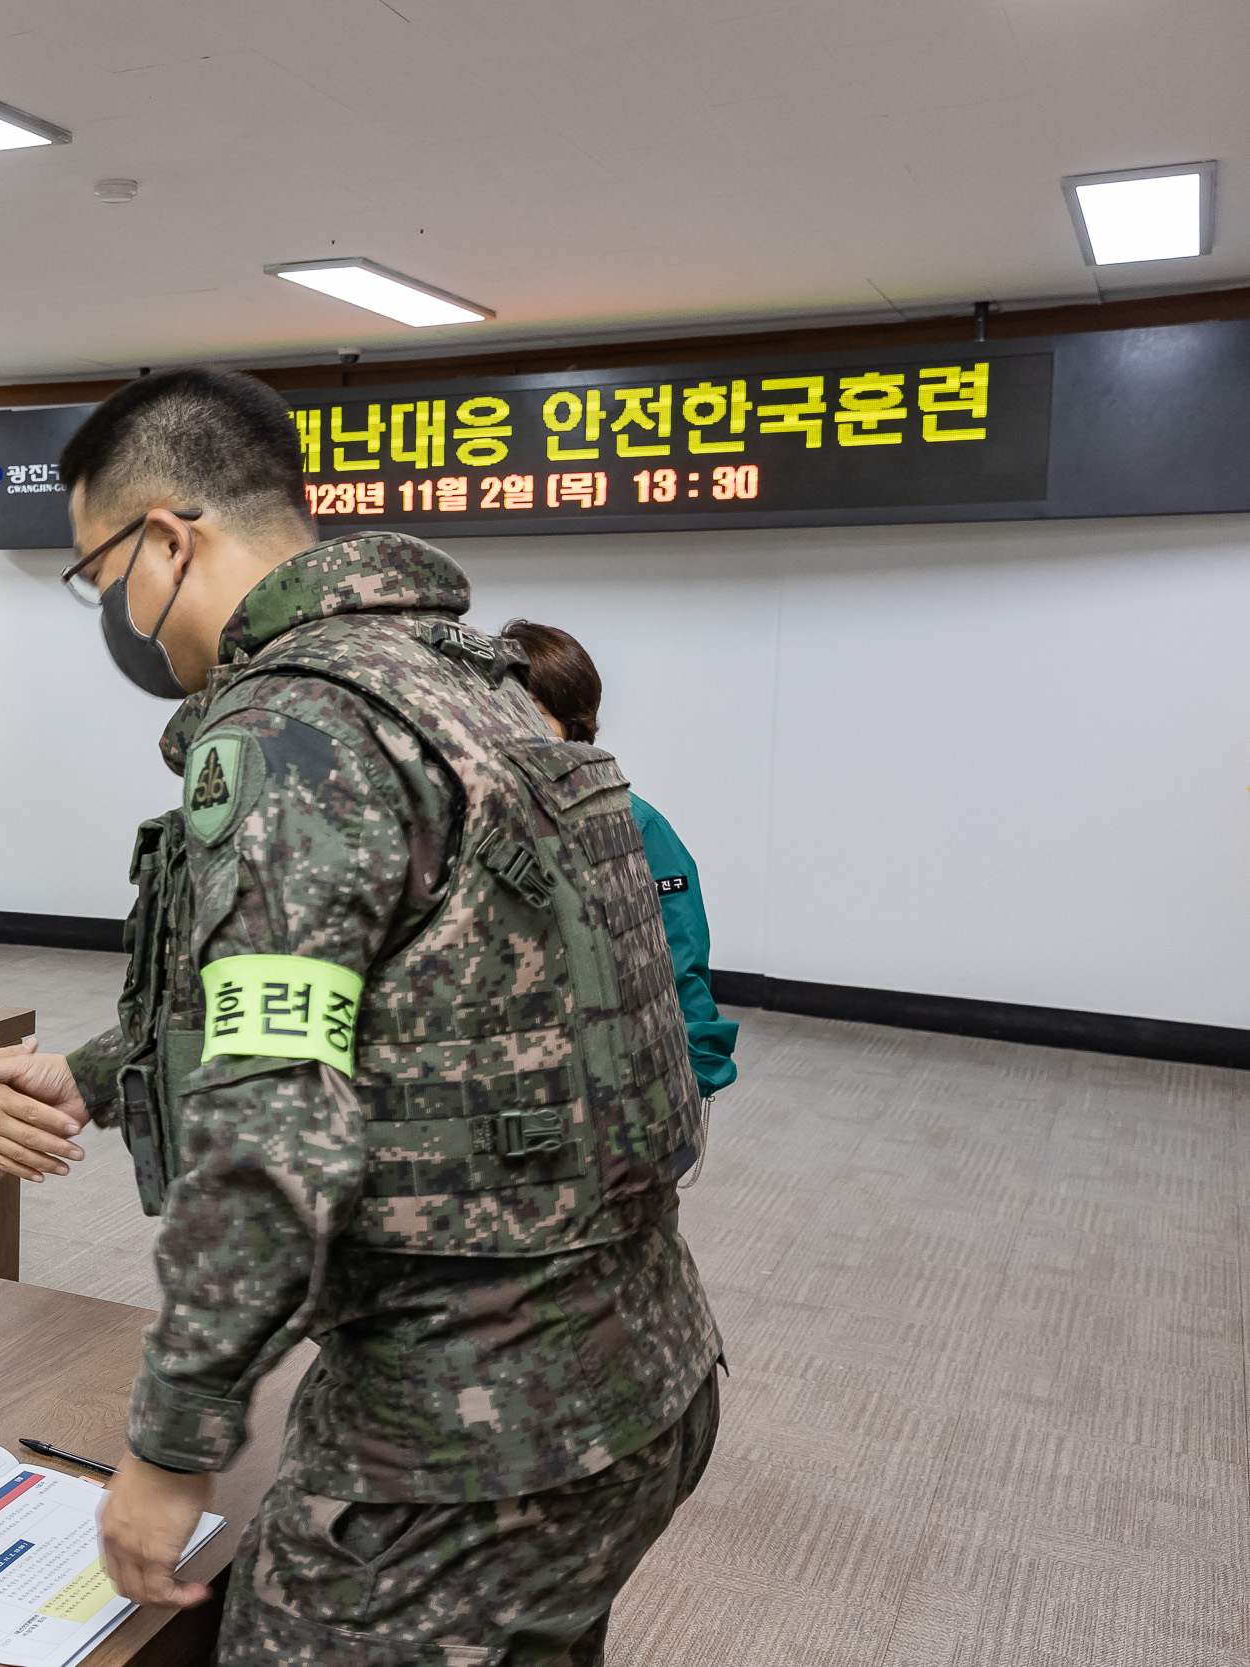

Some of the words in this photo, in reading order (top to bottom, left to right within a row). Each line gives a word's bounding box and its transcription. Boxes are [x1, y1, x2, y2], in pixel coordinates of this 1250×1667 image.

[542, 362, 990, 461] 안전한국훈련
[398, 476, 468, 511] 11월
[480, 474, 534, 510] 2일
